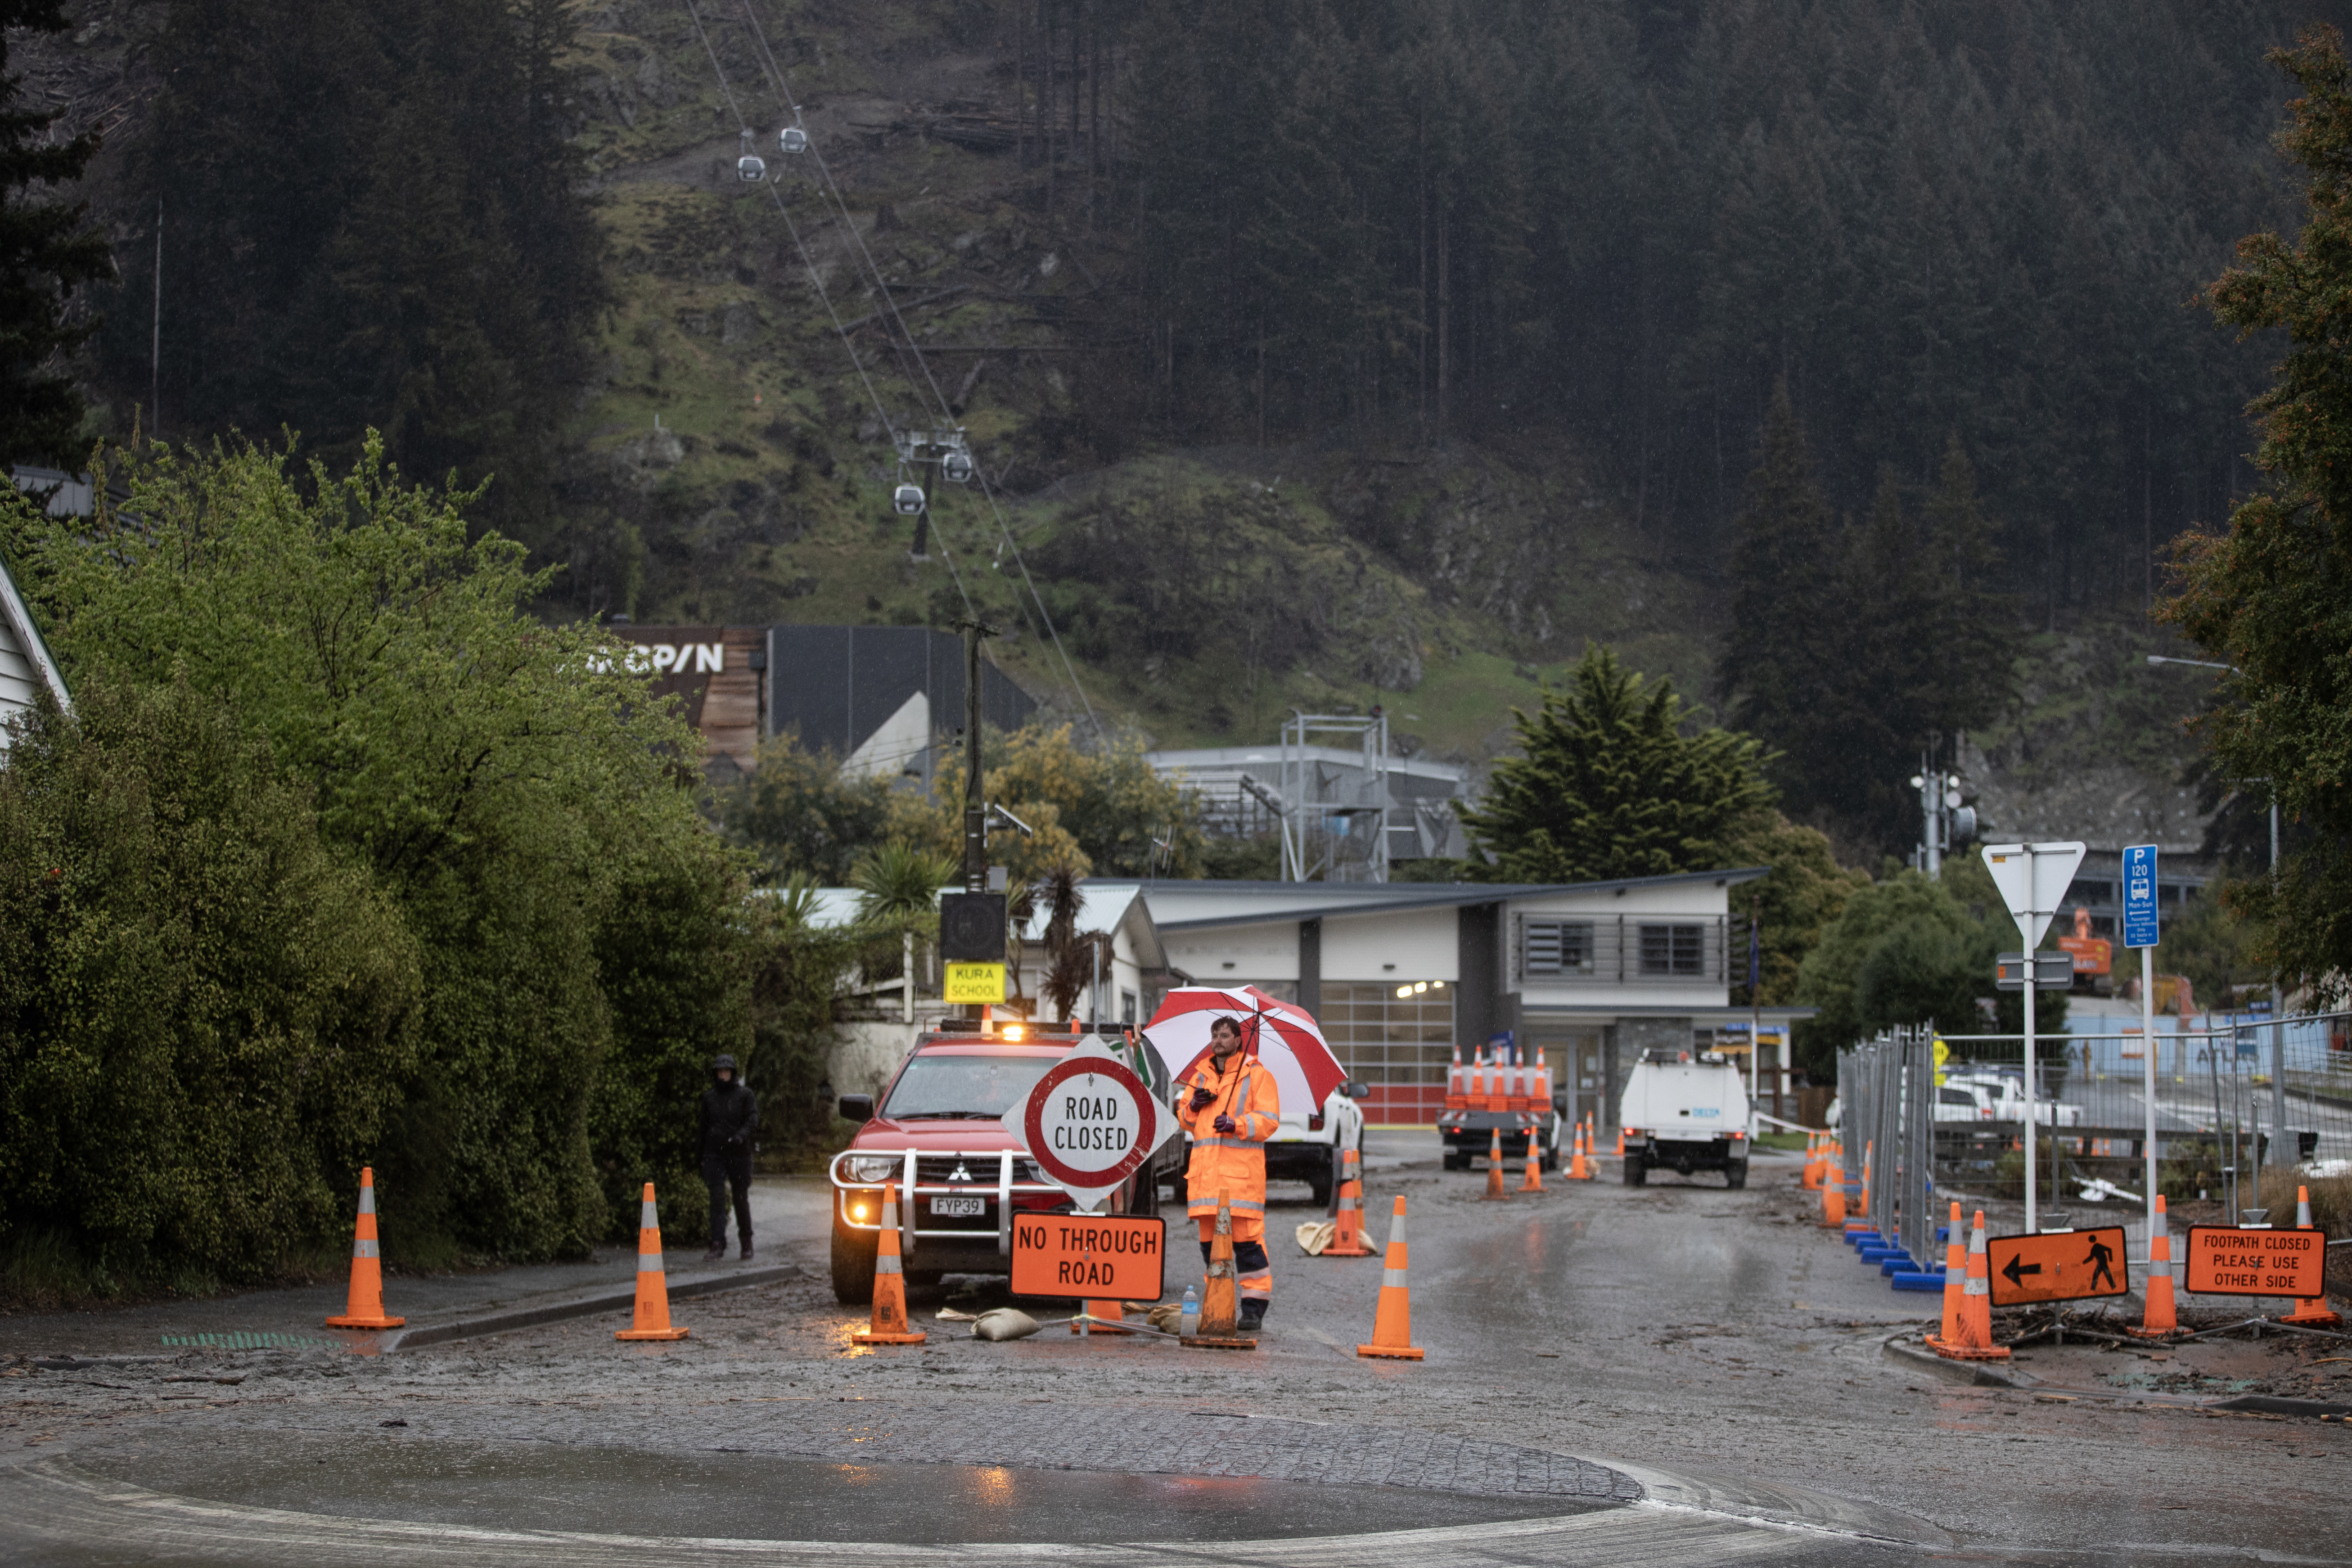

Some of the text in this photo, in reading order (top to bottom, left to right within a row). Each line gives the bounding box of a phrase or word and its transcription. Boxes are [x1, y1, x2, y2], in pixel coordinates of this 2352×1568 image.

[2134, 849, 2145, 864] P
[2132, 864, 2148, 877] 120
[956, 969, 993, 980] KURA
[951, 984, 998, 996] SCHOOL
[1066, 1097, 1117, 1121] ROAD
[1055, 1126, 1127, 1150] CLOSED
[937, 1199, 979, 1213] FYP39
[1019, 1226, 1156, 1254] NO THROUGH
[2204, 1235, 2310, 1251] FOOTPATH CLOSED
[2213, 1254, 2299, 1269] PLEASE USE
[1059, 1261, 1114, 1286] ROAD
[2214, 1273, 2296, 1289] OTHER SIDE
